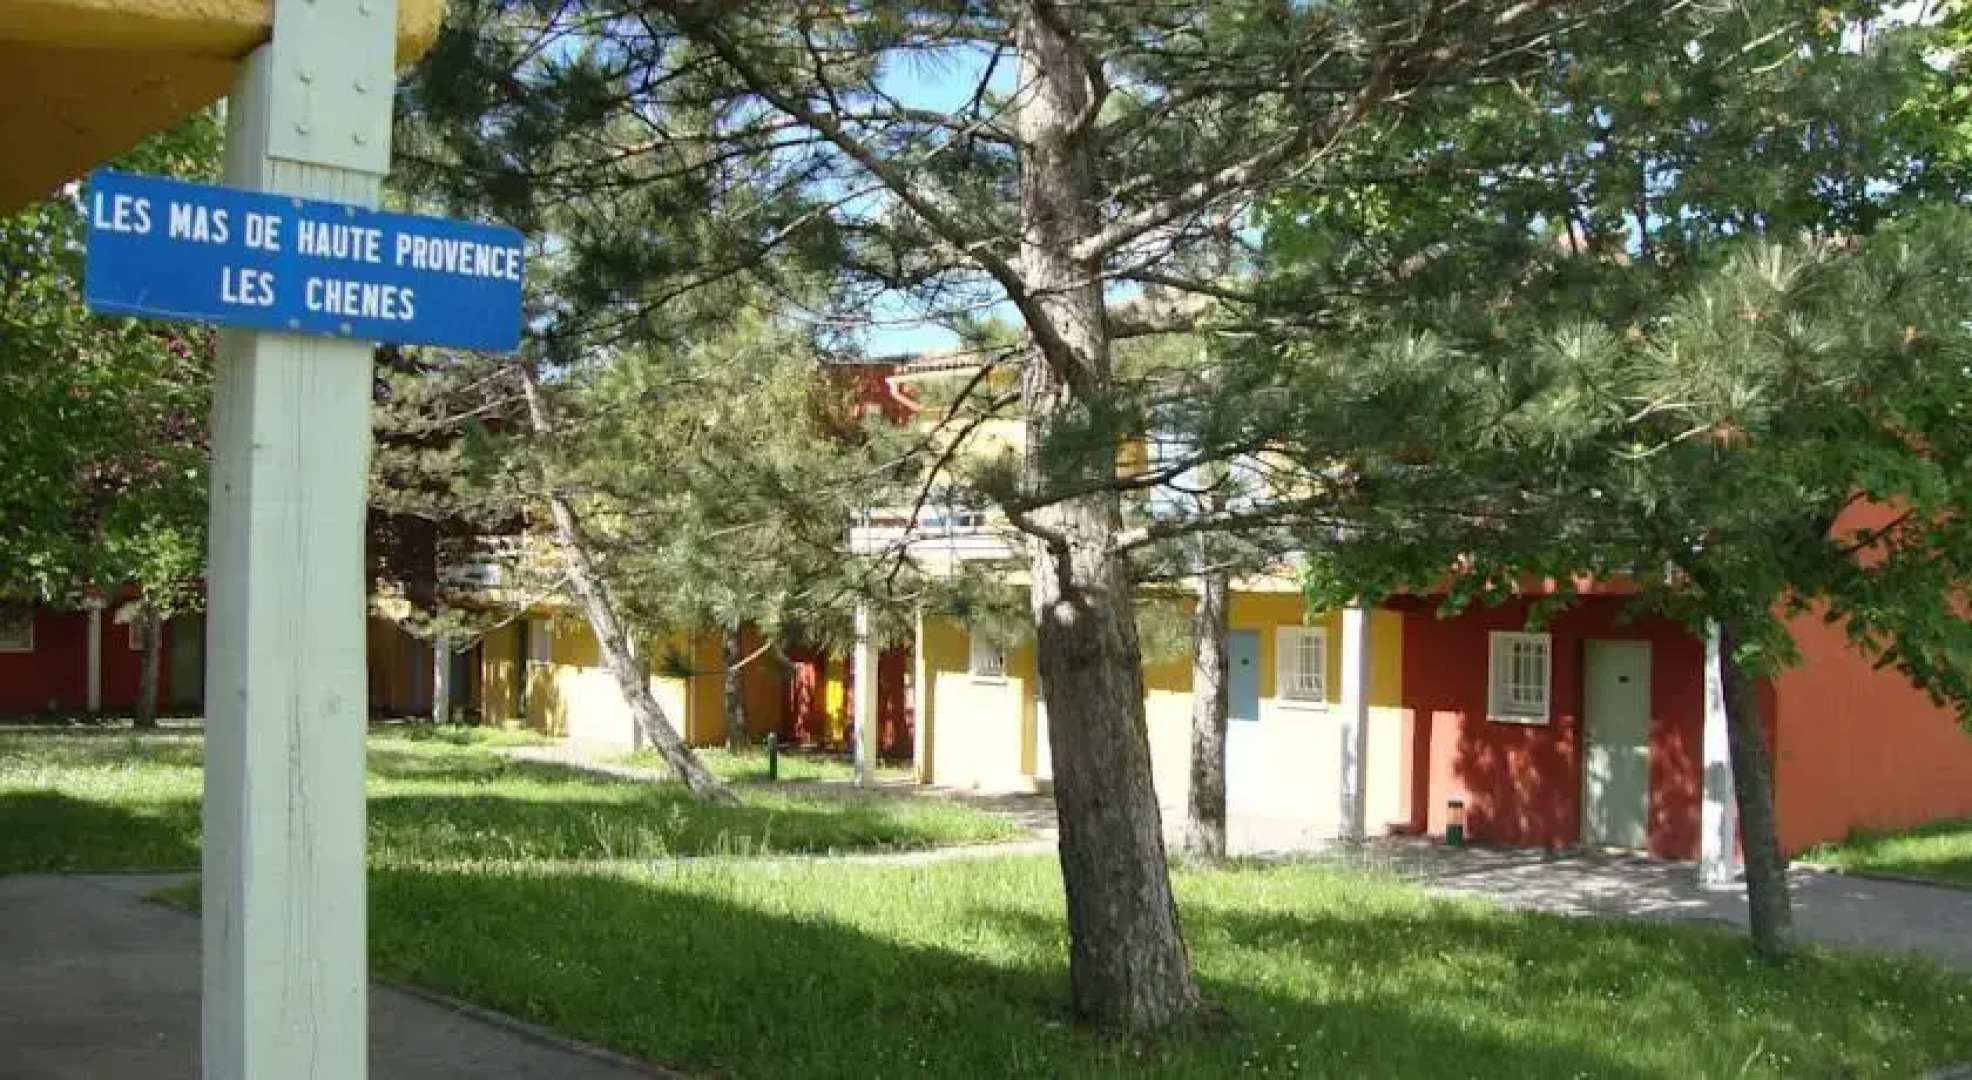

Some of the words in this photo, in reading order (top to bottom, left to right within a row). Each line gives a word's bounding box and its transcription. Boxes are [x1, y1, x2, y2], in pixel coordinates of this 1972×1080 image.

[94, 192, 151, 233] LES
[168, 202, 229, 244] MAS
[245, 213, 282, 251] DE
[298, 220, 383, 264] HAUTE
[395, 233, 520, 281] PROVENCE
[222, 267, 275, 306] LES
[306, 278, 414, 320] CHENES
